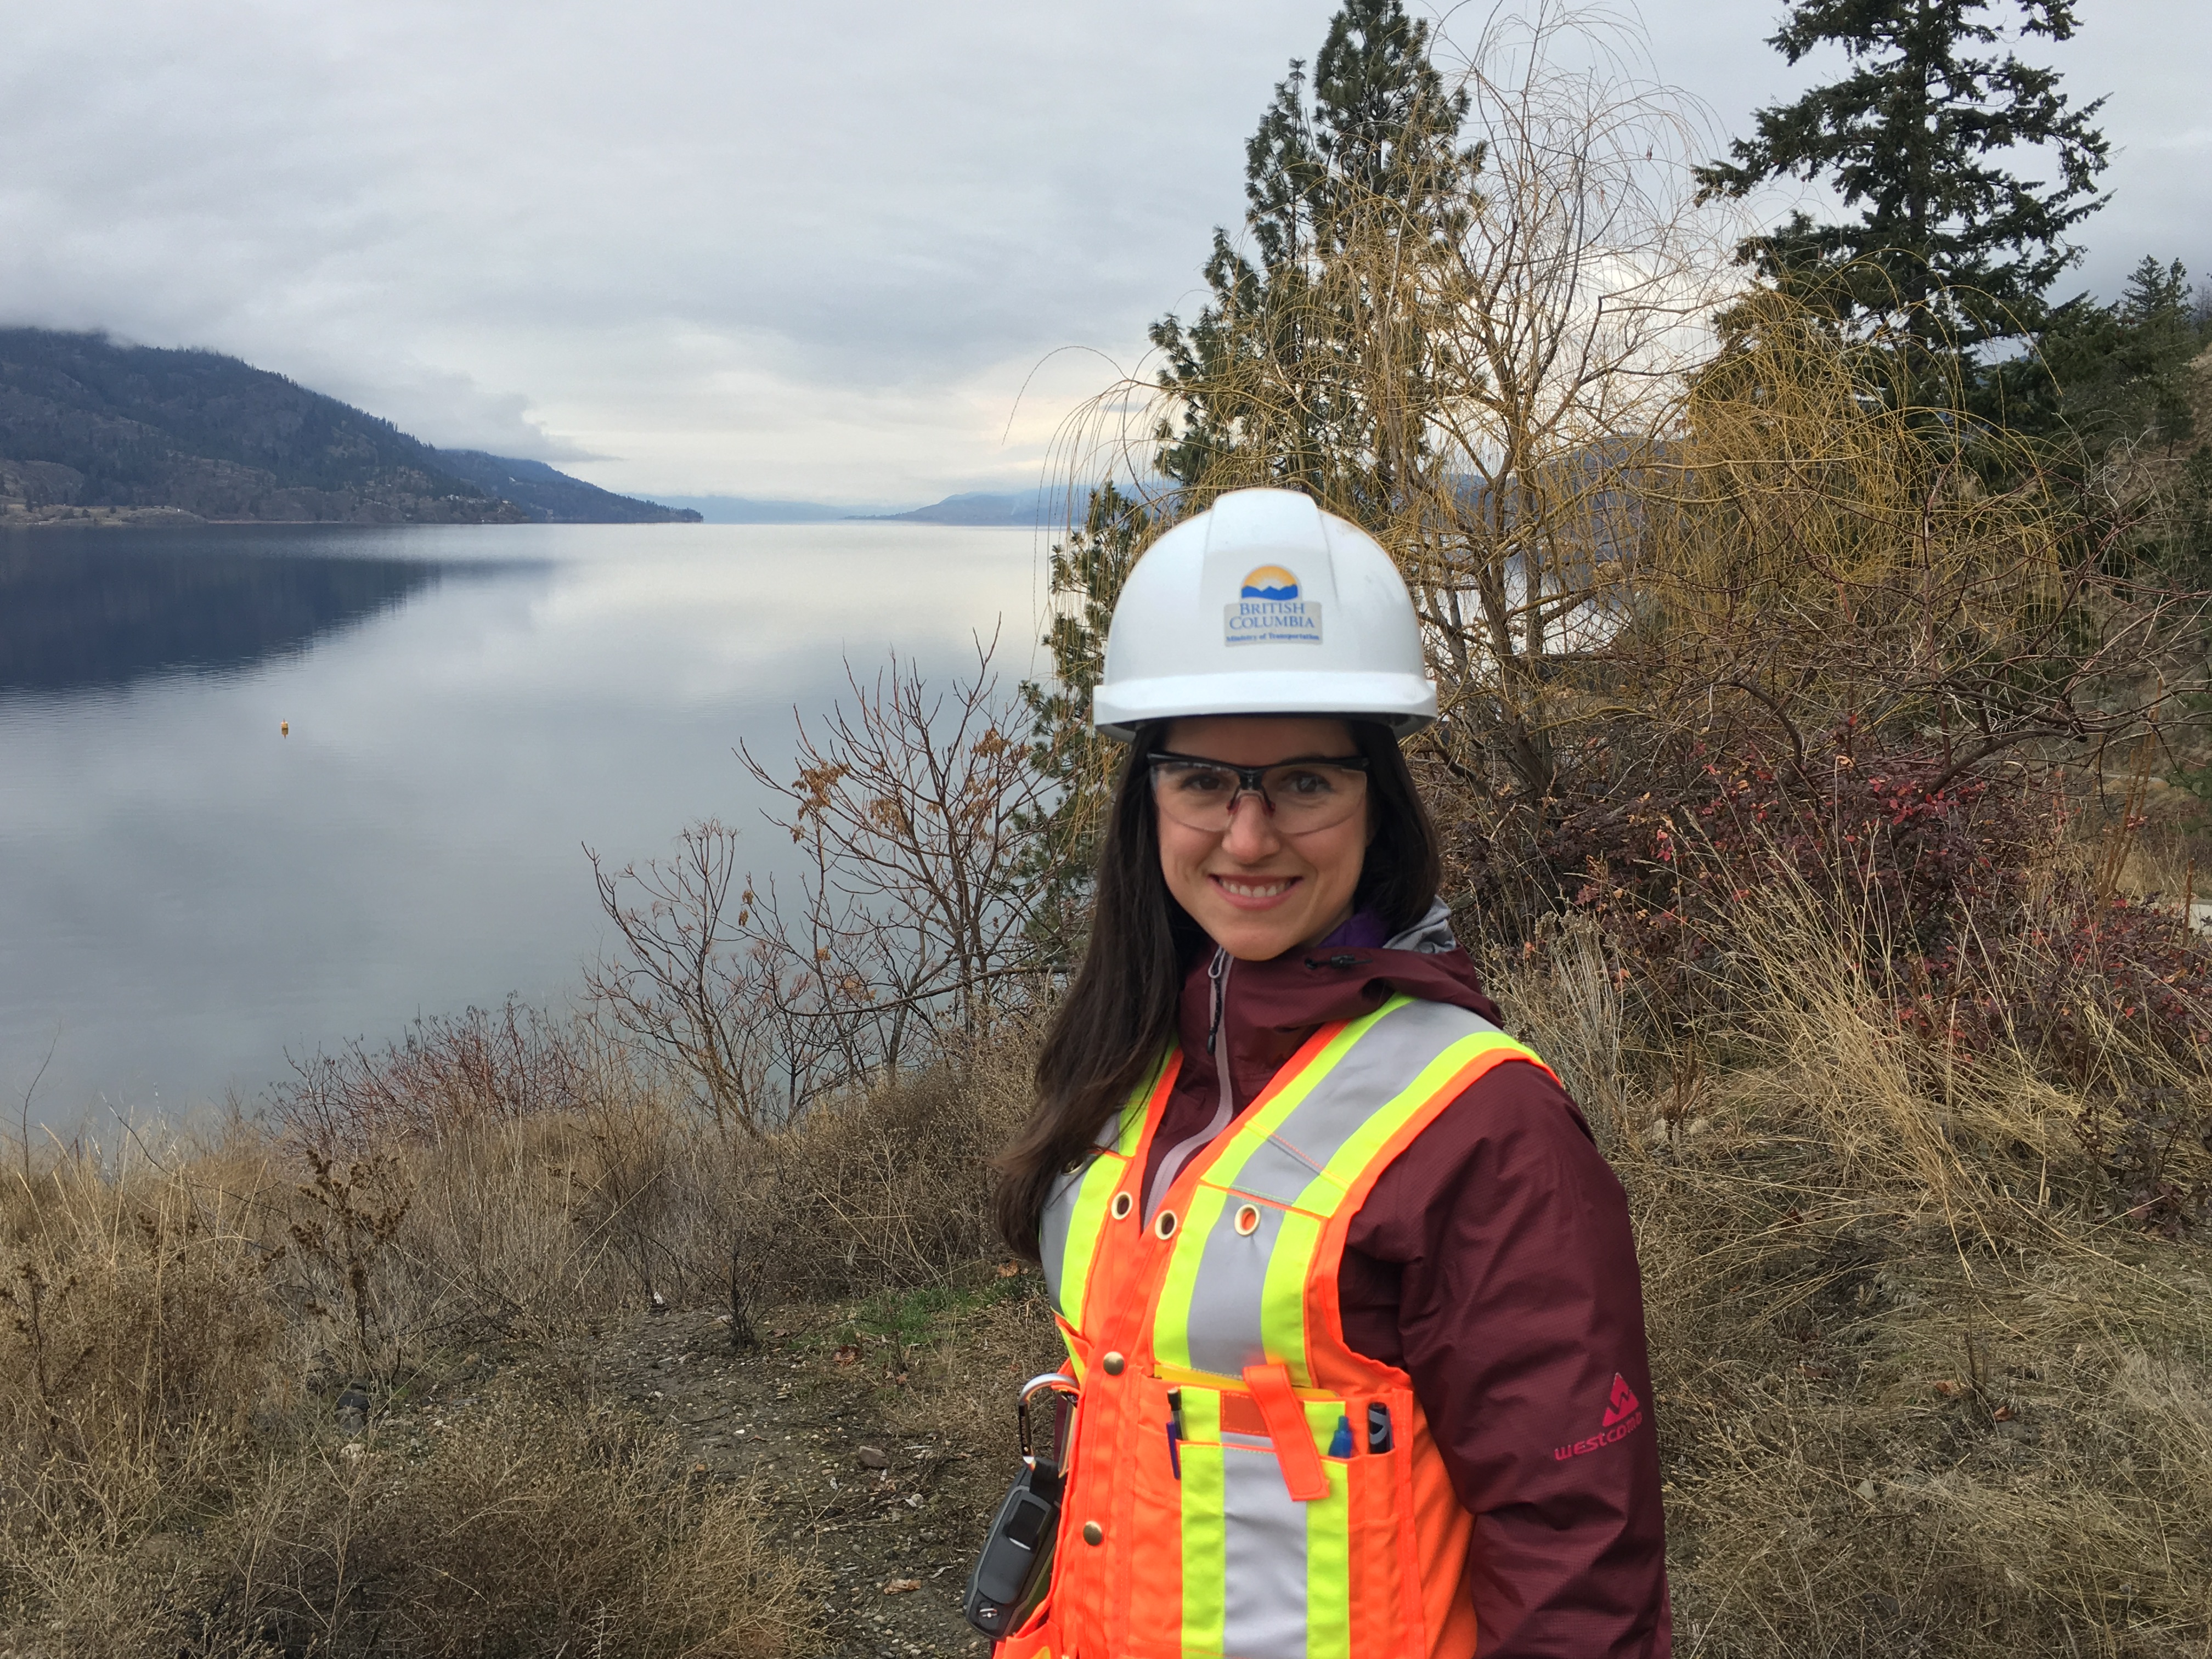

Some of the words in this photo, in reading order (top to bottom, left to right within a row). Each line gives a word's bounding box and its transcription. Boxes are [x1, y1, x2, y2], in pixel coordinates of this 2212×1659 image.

[1240, 602, 1305, 615] BRITISH
[1229, 616, 1314, 629] COLUMBIA
[1268, 632, 1319, 641] Transportation
